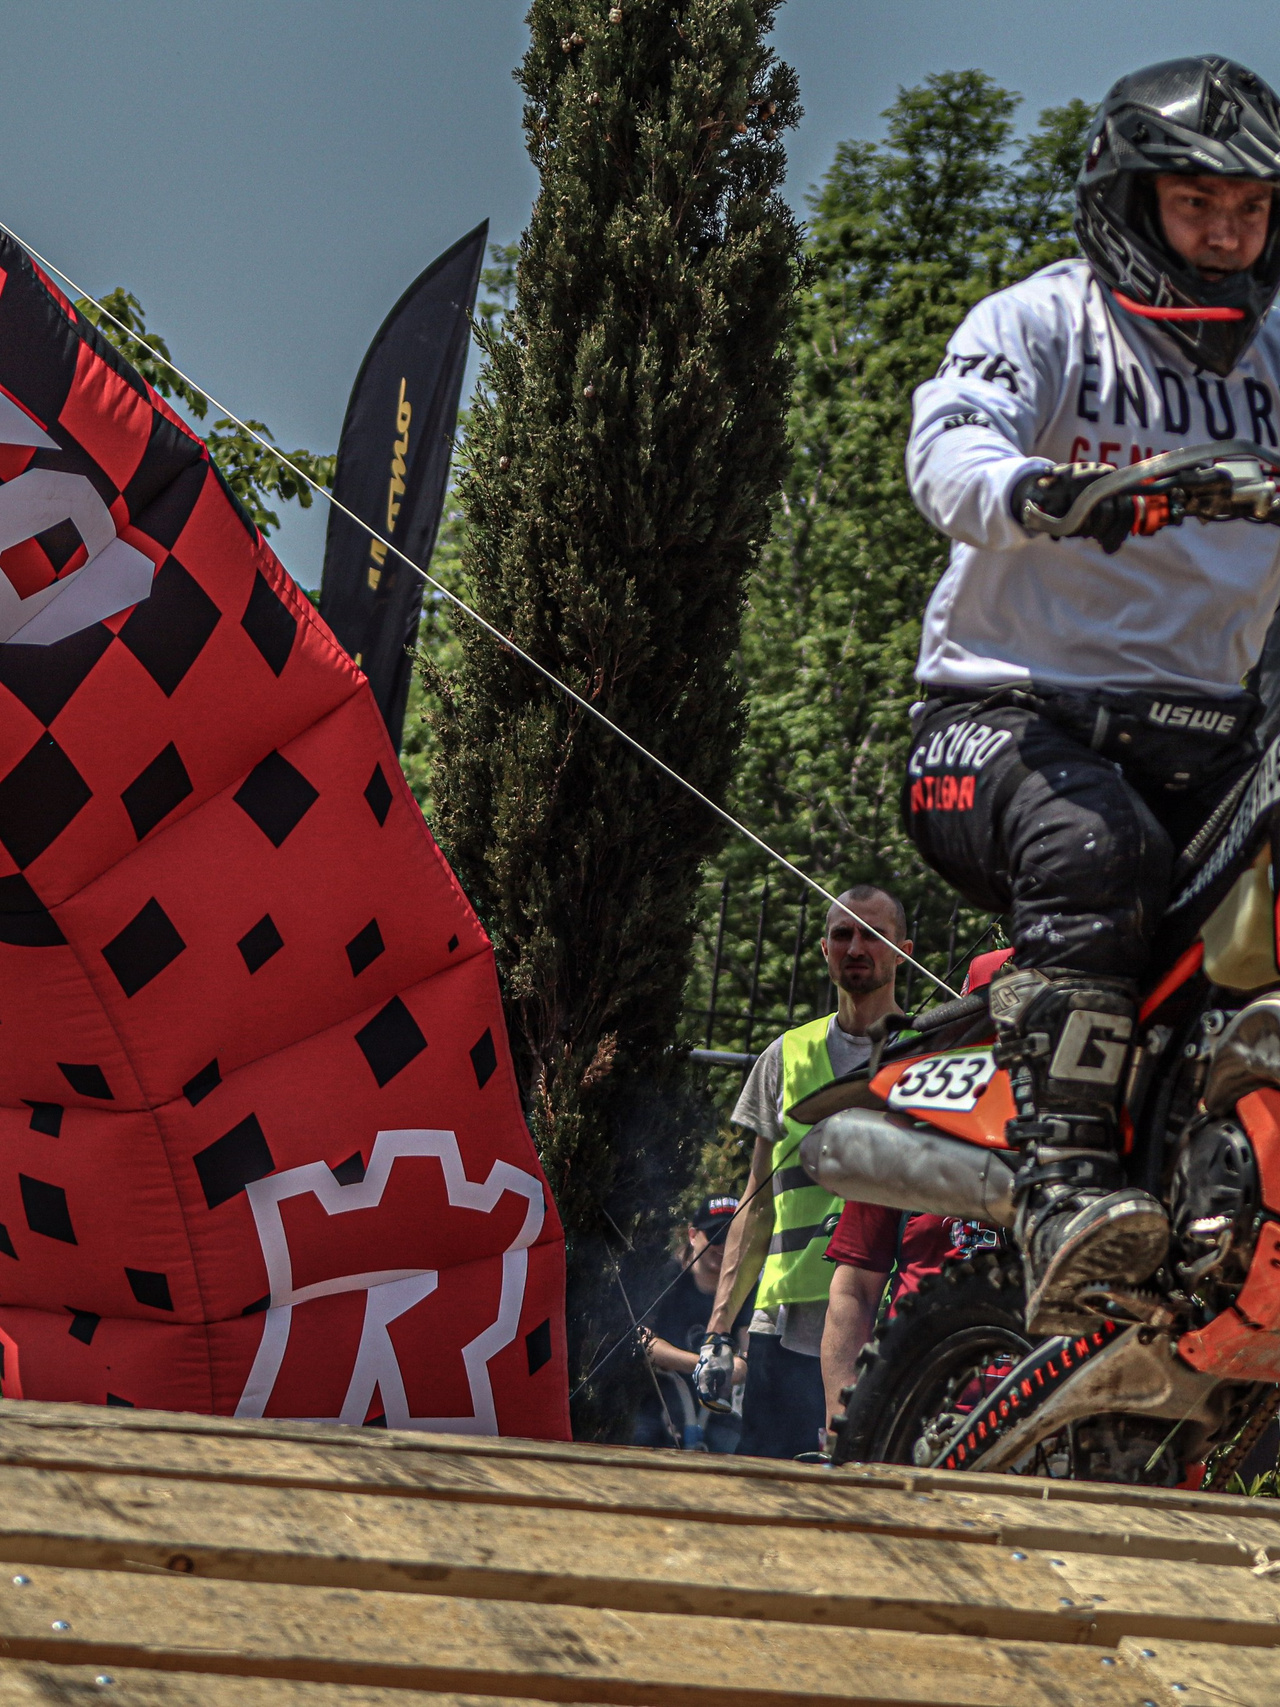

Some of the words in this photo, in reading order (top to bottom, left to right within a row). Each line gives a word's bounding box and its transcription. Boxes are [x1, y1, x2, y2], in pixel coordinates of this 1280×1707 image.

[1148, 701, 1237, 734] USWE
[899, 1057, 988, 1100] 353
[938, 1319, 1117, 1471] NDUROGENTLEMEN
